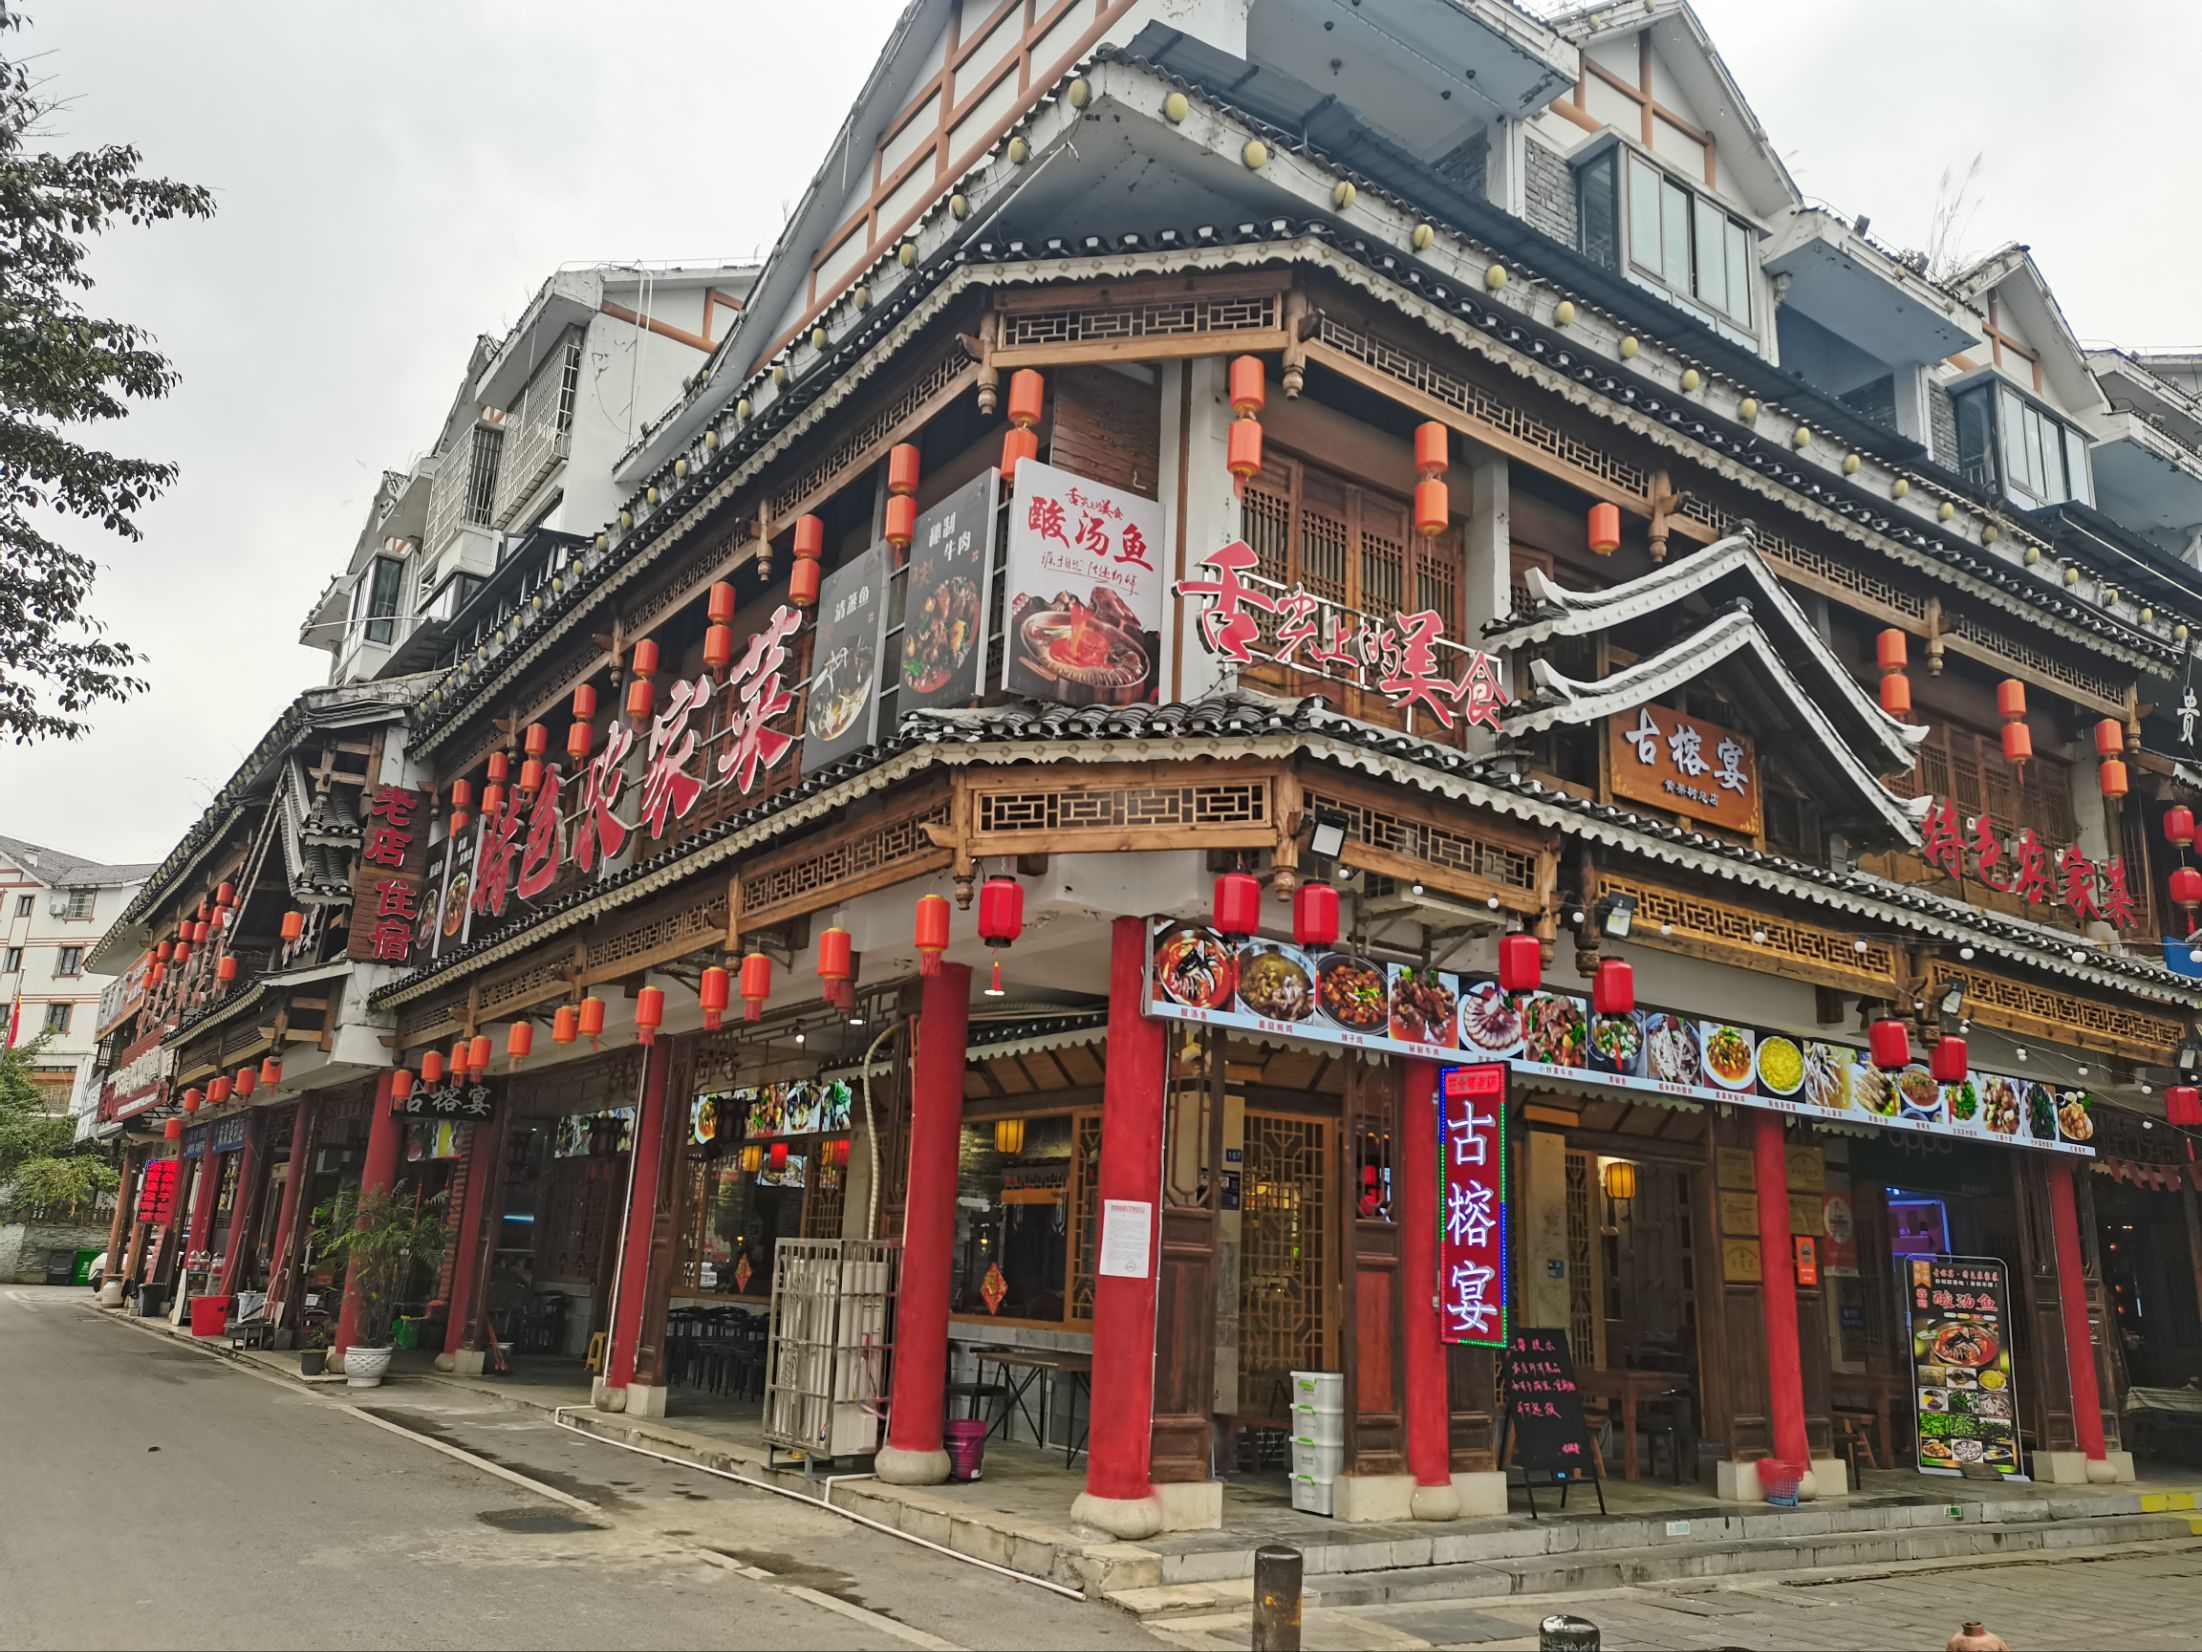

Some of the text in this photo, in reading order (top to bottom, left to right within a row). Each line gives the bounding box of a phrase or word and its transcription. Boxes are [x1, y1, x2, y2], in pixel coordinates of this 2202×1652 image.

[944, 531, 971, 562] 牛肉
[1028, 495, 1154, 572] 酸汤鱼
[834, 585, 870, 623] 清蒸鱼
[1172, 539, 1510, 731] 舌尖上的美食
[470, 604, 804, 917] 特色农家菜
[1625, 707, 1749, 797] 古榕宴
[1663, 779, 1720, 807] 黄果树总店
[365, 785, 418, 961] 老店 住宿
[1920, 795, 2139, 930] 特色农家菜
[1181, 1007, 1207, 1021] 酸汤鱼
[1341, 1032, 1364, 1045] 辣子鸡
[405, 1079, 492, 1116] 古榕宴
[1228, 1152, 1241, 1160] 107
[1446, 1099, 1498, 1334] 古榕宴
[1932, 1289, 1999, 1311] 酸汤鱼
